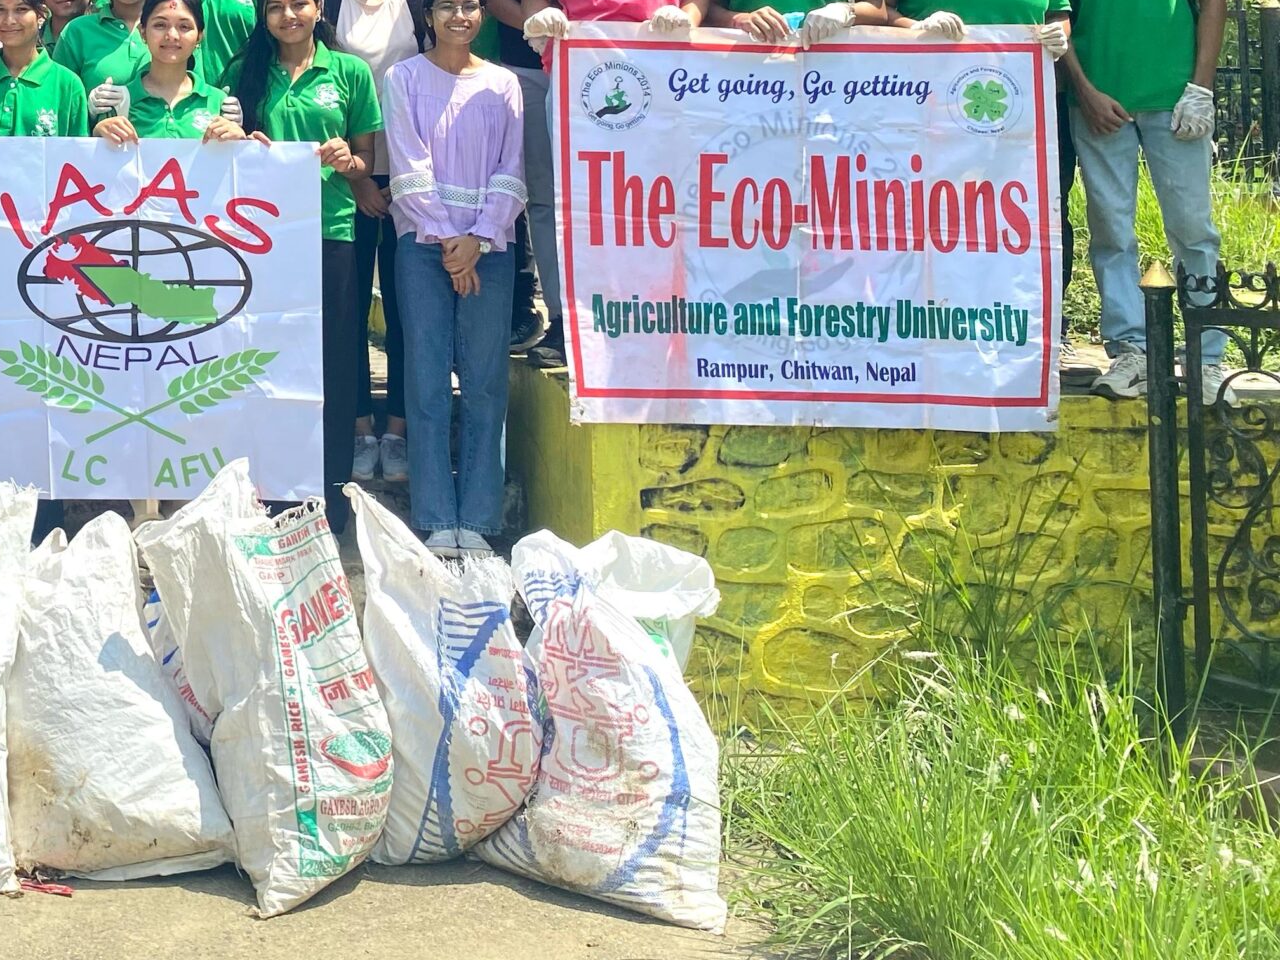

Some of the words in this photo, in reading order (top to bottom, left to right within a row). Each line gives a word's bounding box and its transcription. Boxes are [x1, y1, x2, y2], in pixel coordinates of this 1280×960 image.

[581, 81, 591, 98] The
[588, 67, 603, 81] Eco
[604, 62, 639, 76] Minions
[636, 75, 651, 97] 2014
[668, 67, 711, 102] Get
[718, 74, 796, 102] going,
[802, 70, 836, 103] Go
[843, 74, 933, 103] getting
[0, 158, 280, 255] IAAS
[578, 151, 678, 248] The
[698, 153, 1031, 255] Eco-Minions
[592, 294, 727, 340] Agriculture
[733, 297, 781, 337] and
[788, 297, 891, 344] Forestry
[896, 299, 1029, 348] University
[55, 335, 218, 371] NEPAL
[697, 358, 774, 383] Rampur,
[780, 359, 859, 384] Chitwan,
[866, 361, 916, 386] Nepal
[61, 450, 108, 485] LC
[278, 528, 310, 550] GANESH
[288, 701, 303, 732] RICE
[293, 740, 311, 794] GANESH
